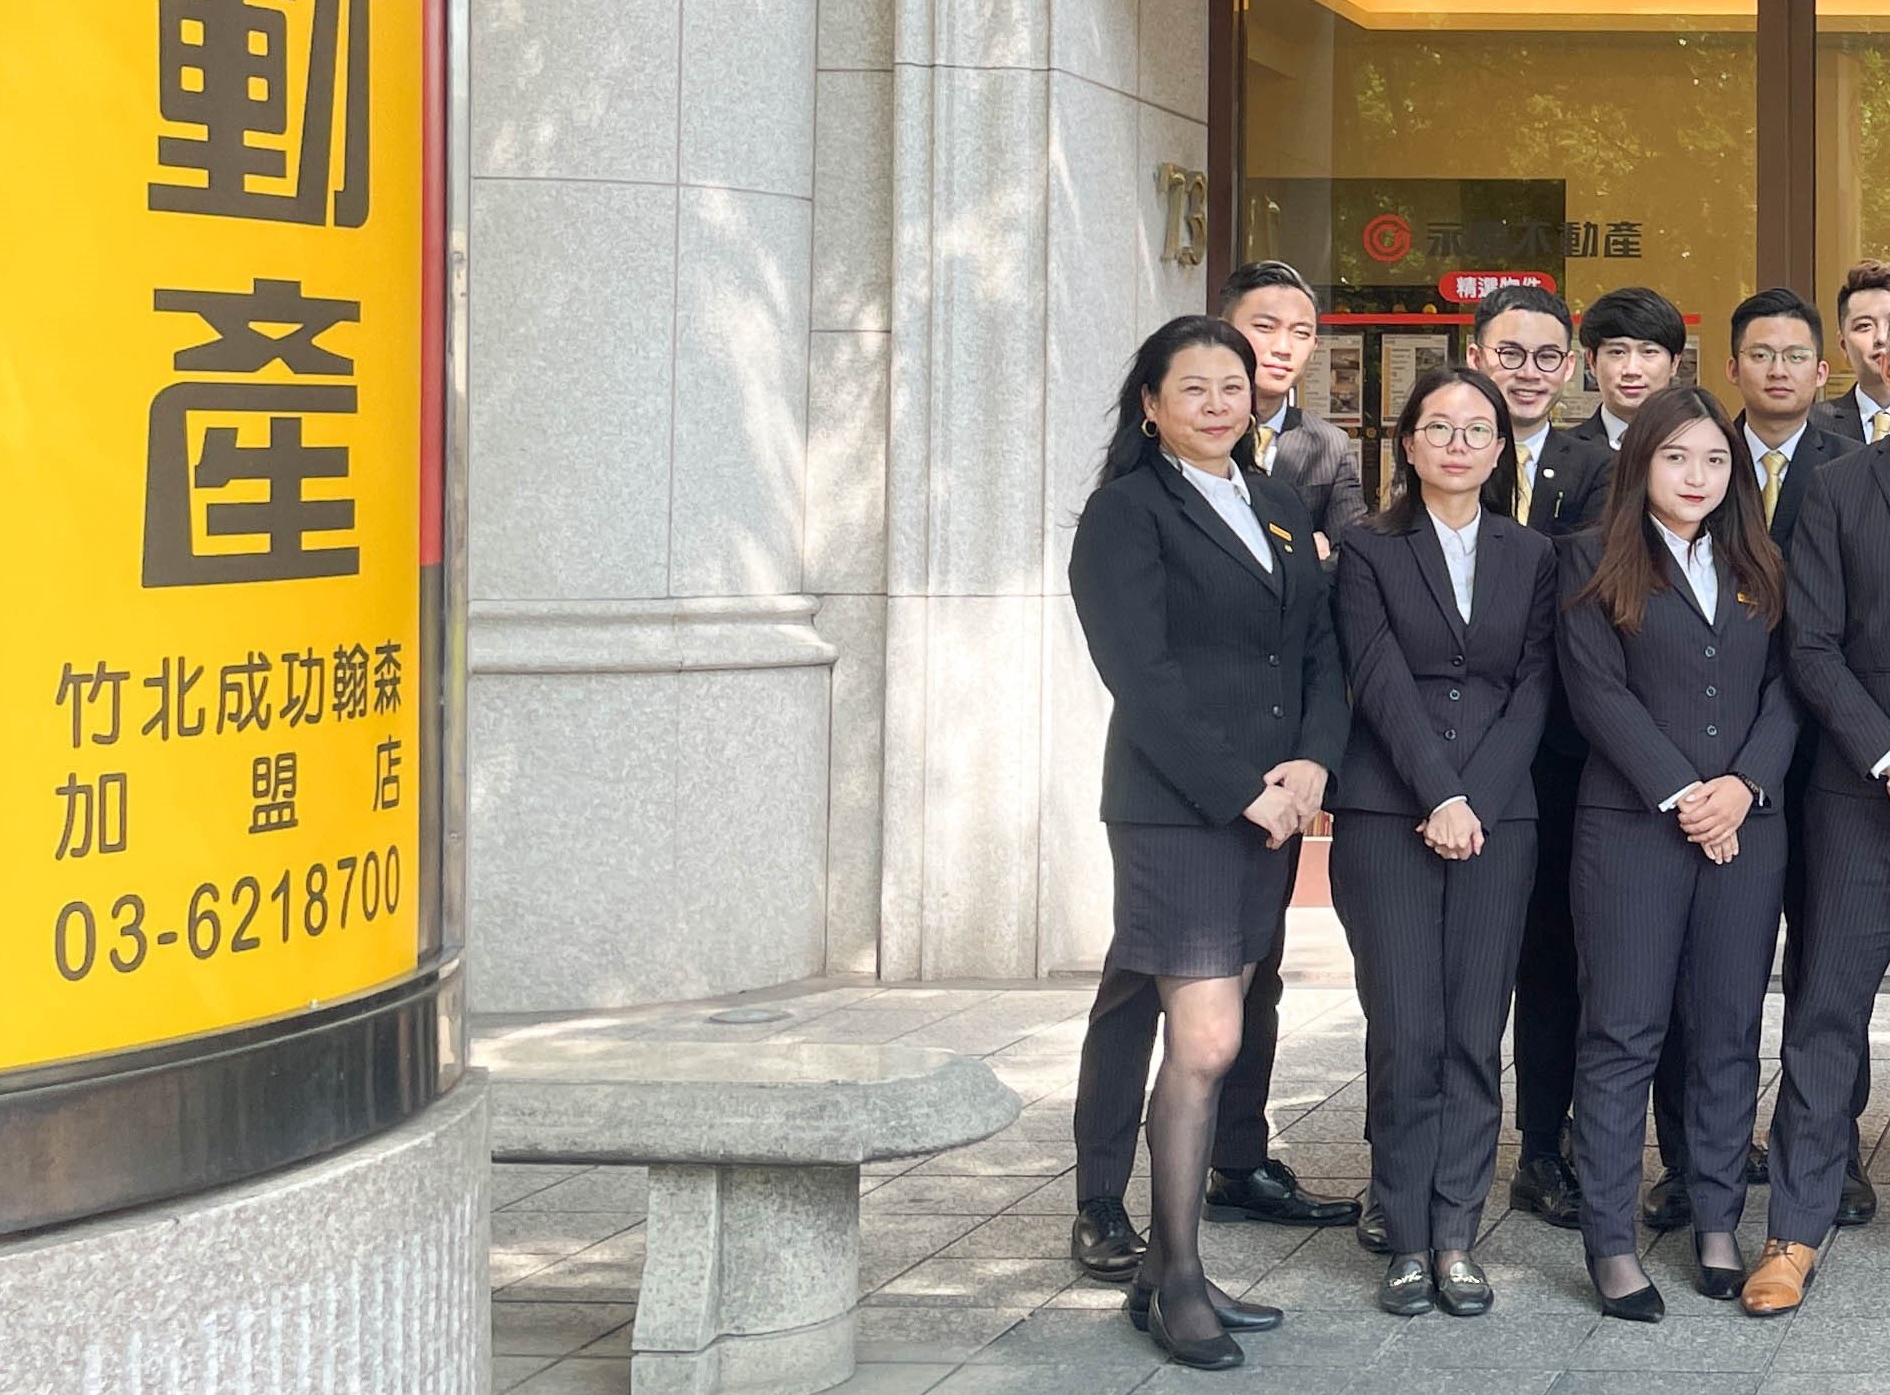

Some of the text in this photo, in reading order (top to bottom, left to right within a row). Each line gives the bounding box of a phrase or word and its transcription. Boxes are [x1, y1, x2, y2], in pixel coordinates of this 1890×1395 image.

[54, 638, 402, 749] 竹北成功翰森
[54, 844, 401, 982] 03-6218700
